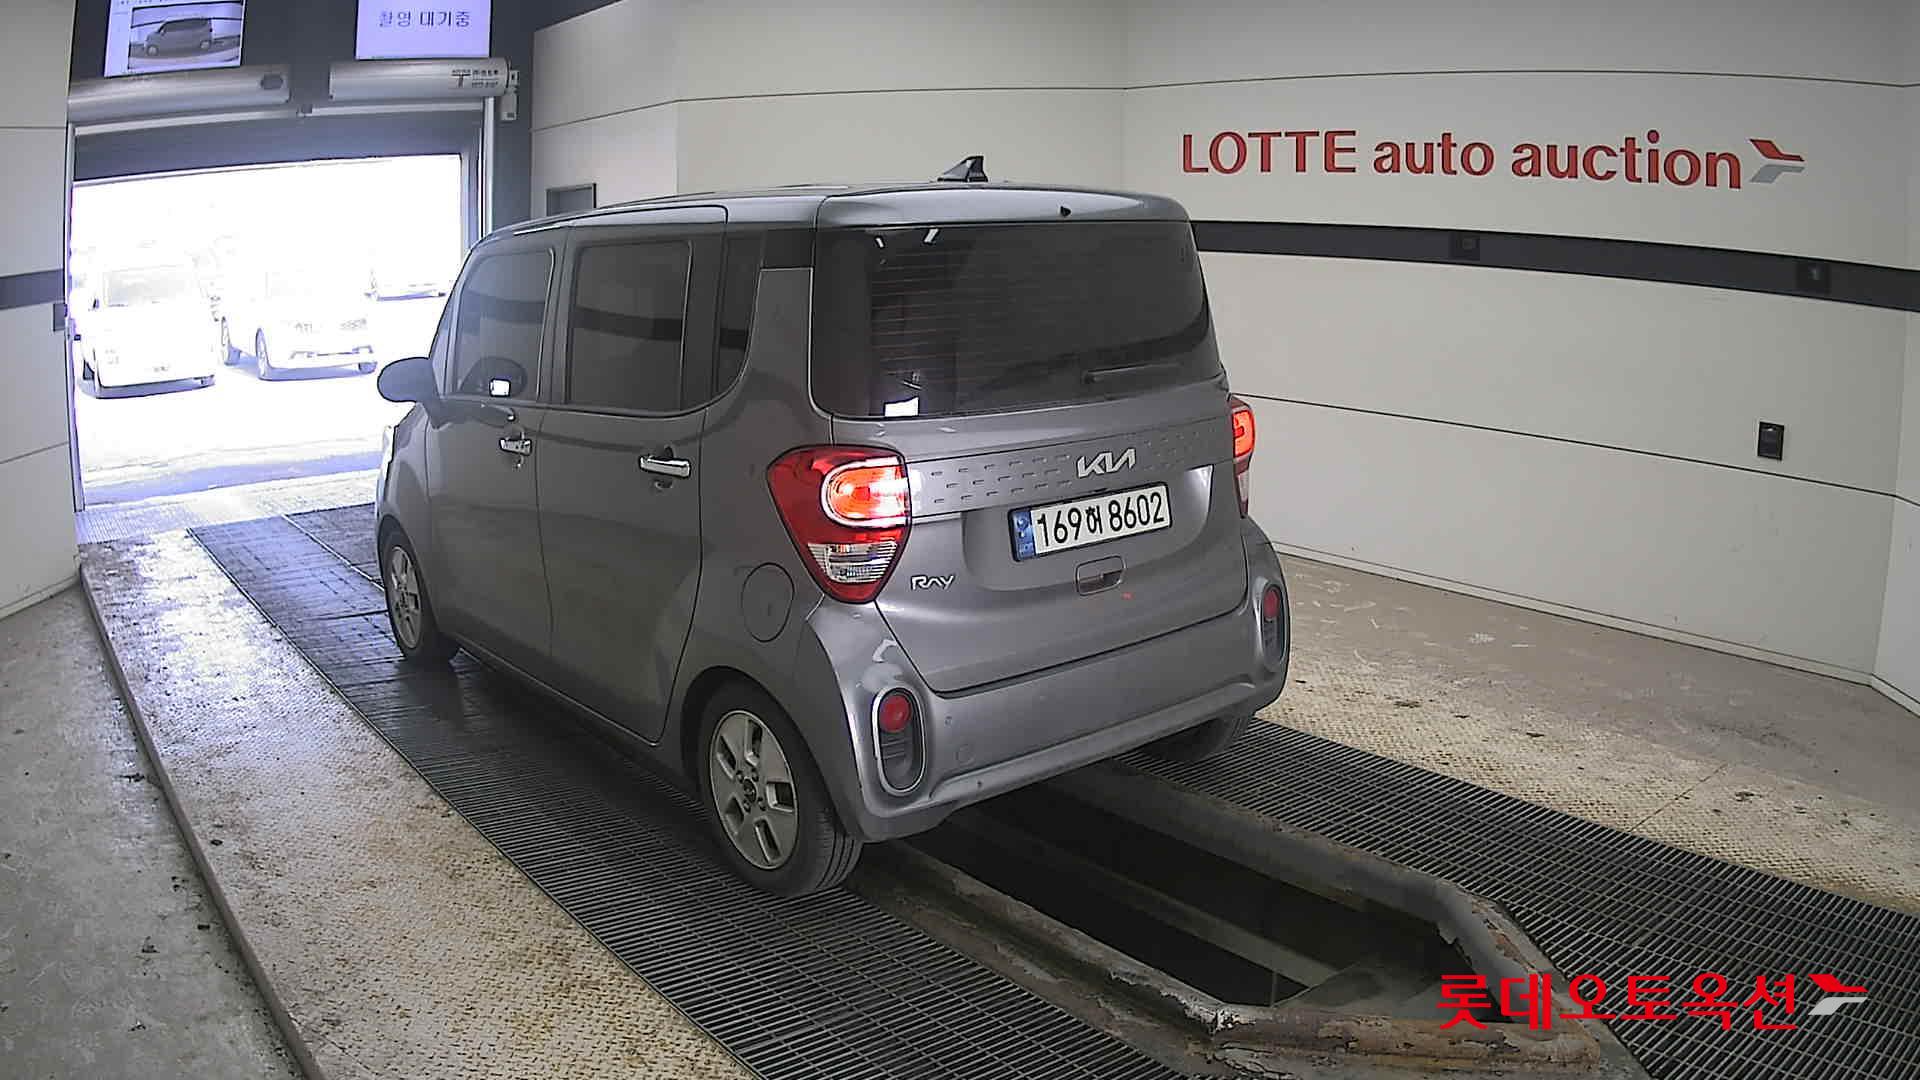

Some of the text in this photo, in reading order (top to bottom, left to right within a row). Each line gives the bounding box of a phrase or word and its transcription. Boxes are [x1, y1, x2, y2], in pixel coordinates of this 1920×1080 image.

[419, 11, 470, 27] 대기중
[1182, 130, 1742, 189] LOTTE auto auction
[1077, 448, 1136, 478] KIA
[1108, 492, 1165, 531] 8602
